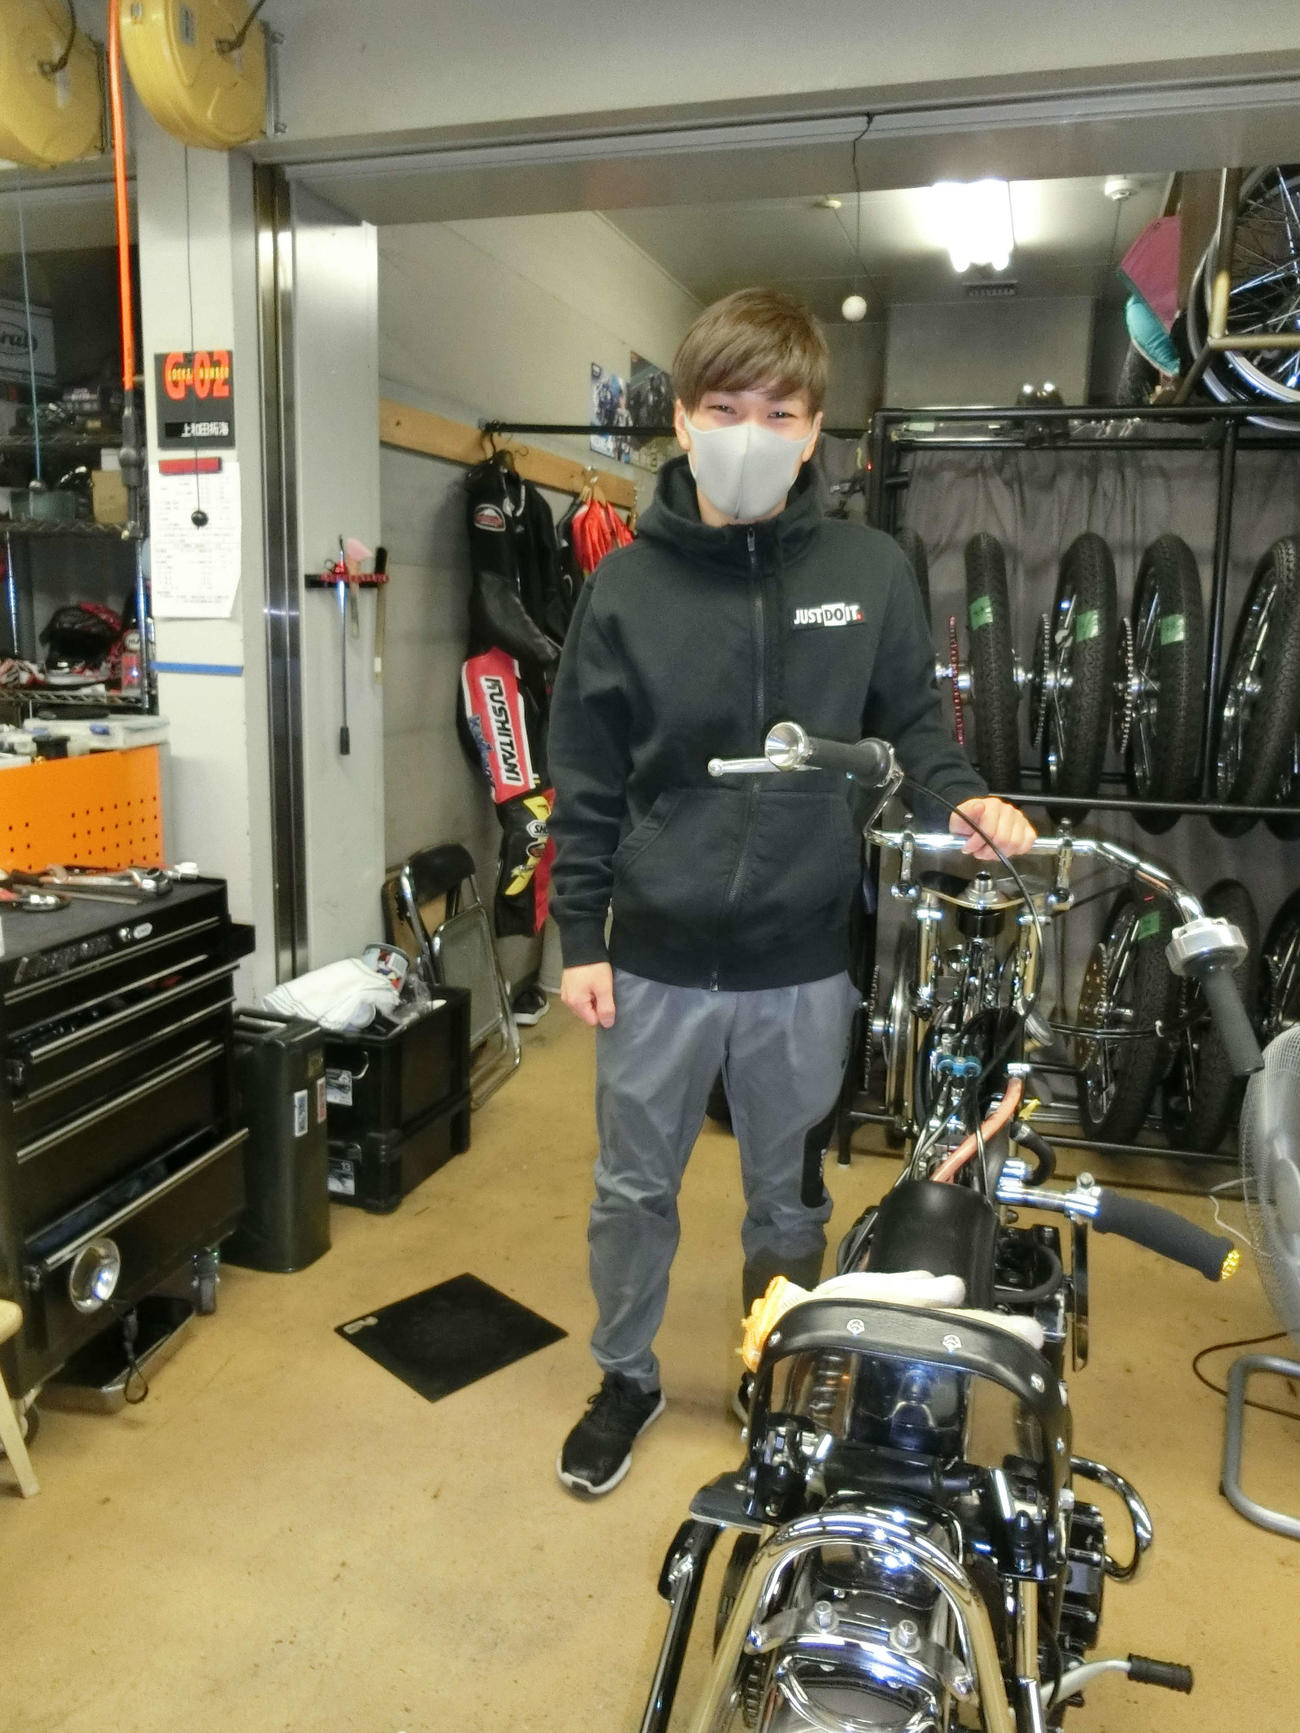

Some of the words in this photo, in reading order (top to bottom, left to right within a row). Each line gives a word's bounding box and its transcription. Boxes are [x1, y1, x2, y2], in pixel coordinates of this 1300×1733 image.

[164, 350, 230, 400] G-02
[794, 608, 823, 625] JUST
[823, 606, 845, 623] DO
